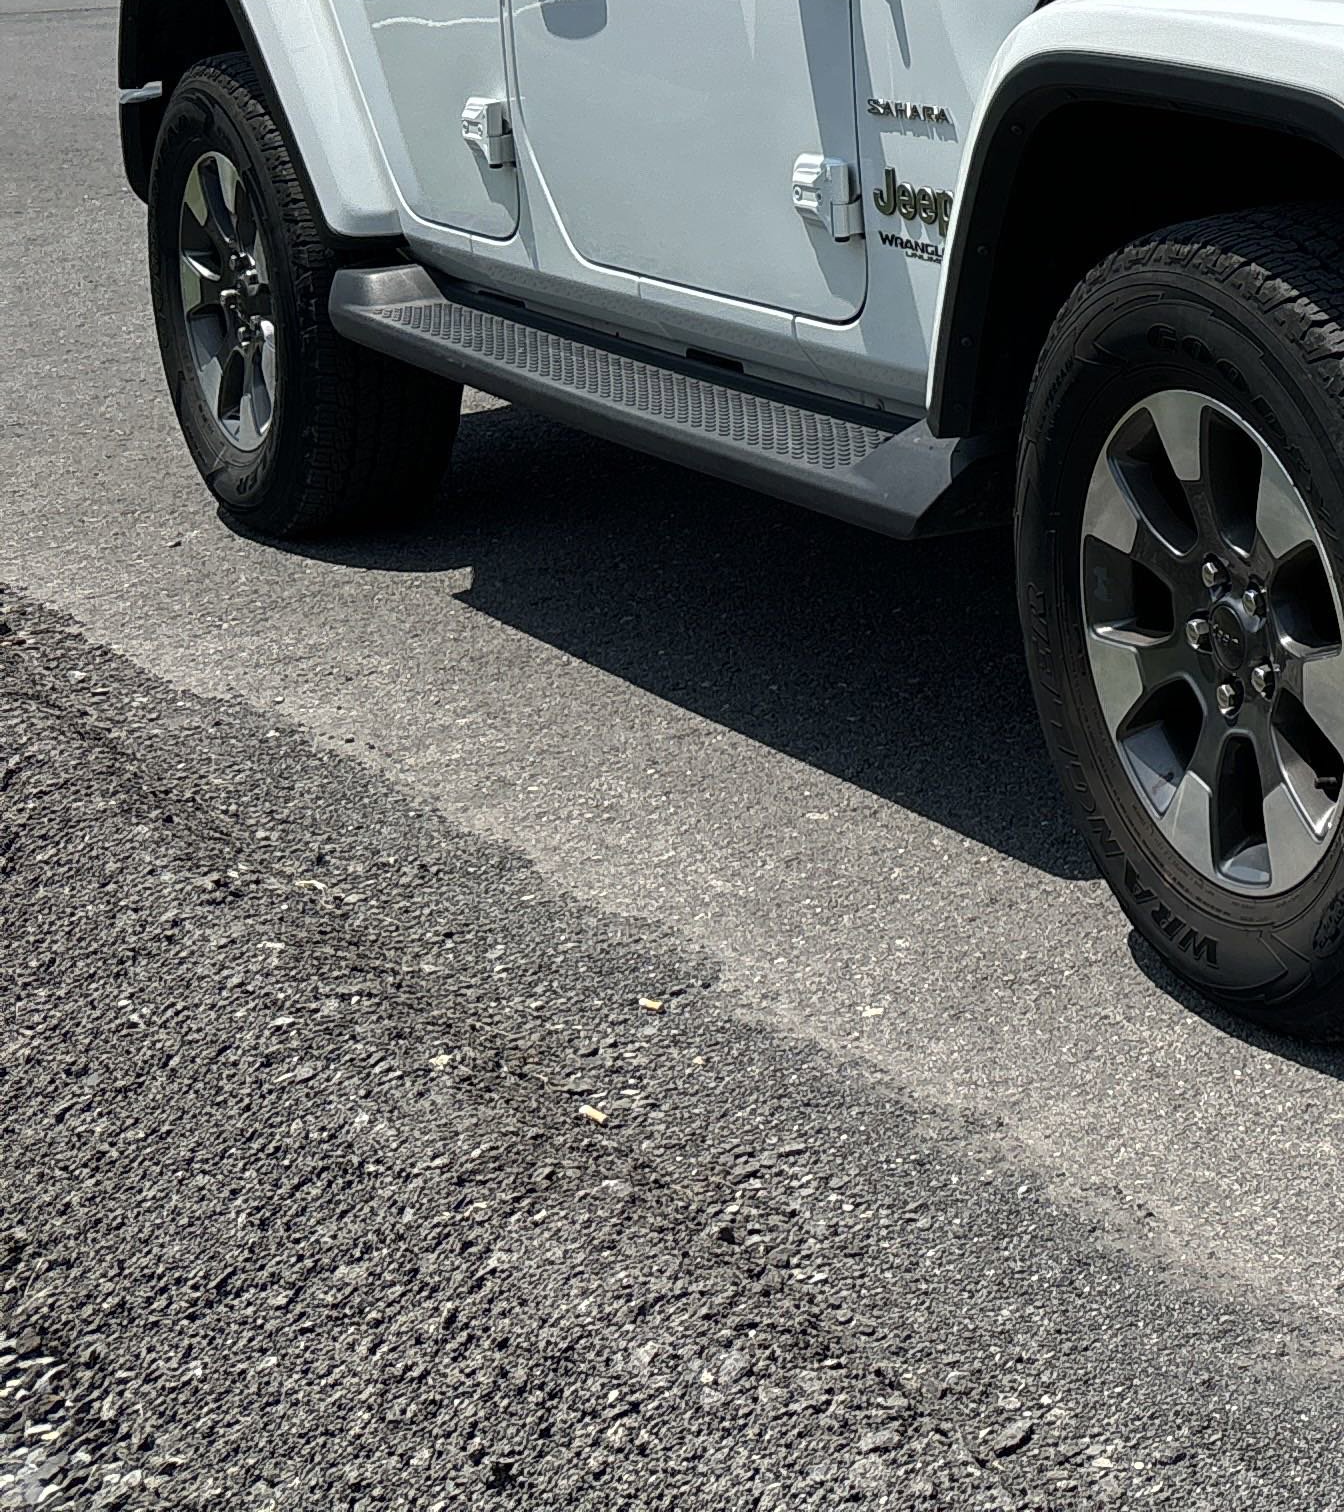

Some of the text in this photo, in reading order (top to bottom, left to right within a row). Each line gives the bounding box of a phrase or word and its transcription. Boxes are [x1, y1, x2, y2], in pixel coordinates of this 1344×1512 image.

[866, 98, 954, 126] SAHARA
[872, 166, 955, 238] Jeep
[878, 230, 945, 258] WRANGL
